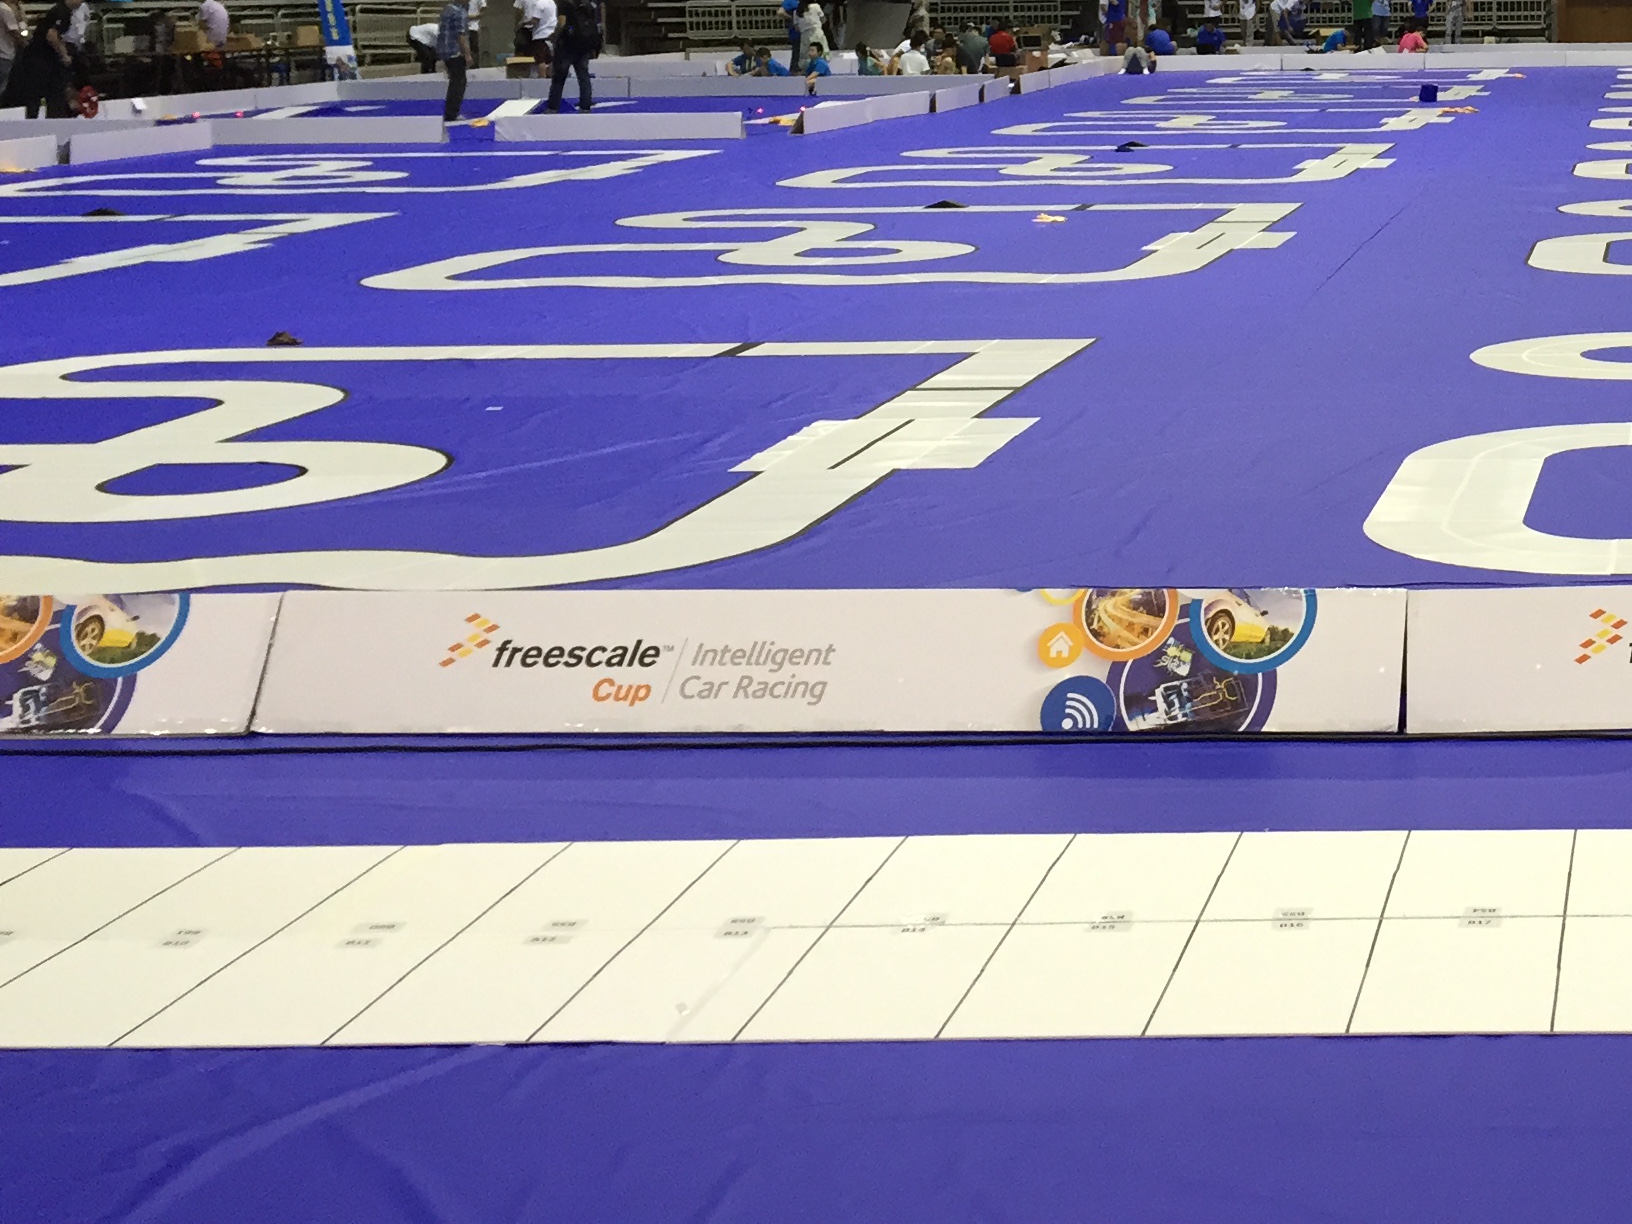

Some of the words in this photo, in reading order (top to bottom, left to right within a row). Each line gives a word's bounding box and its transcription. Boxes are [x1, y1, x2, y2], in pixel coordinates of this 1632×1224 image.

[491, 638, 661, 669] freescale
[691, 640, 837, 673] Intelligent
[591, 677, 652, 707] Cup
[678, 675, 728, 701] Car
[733, 674, 829, 706] Racing
